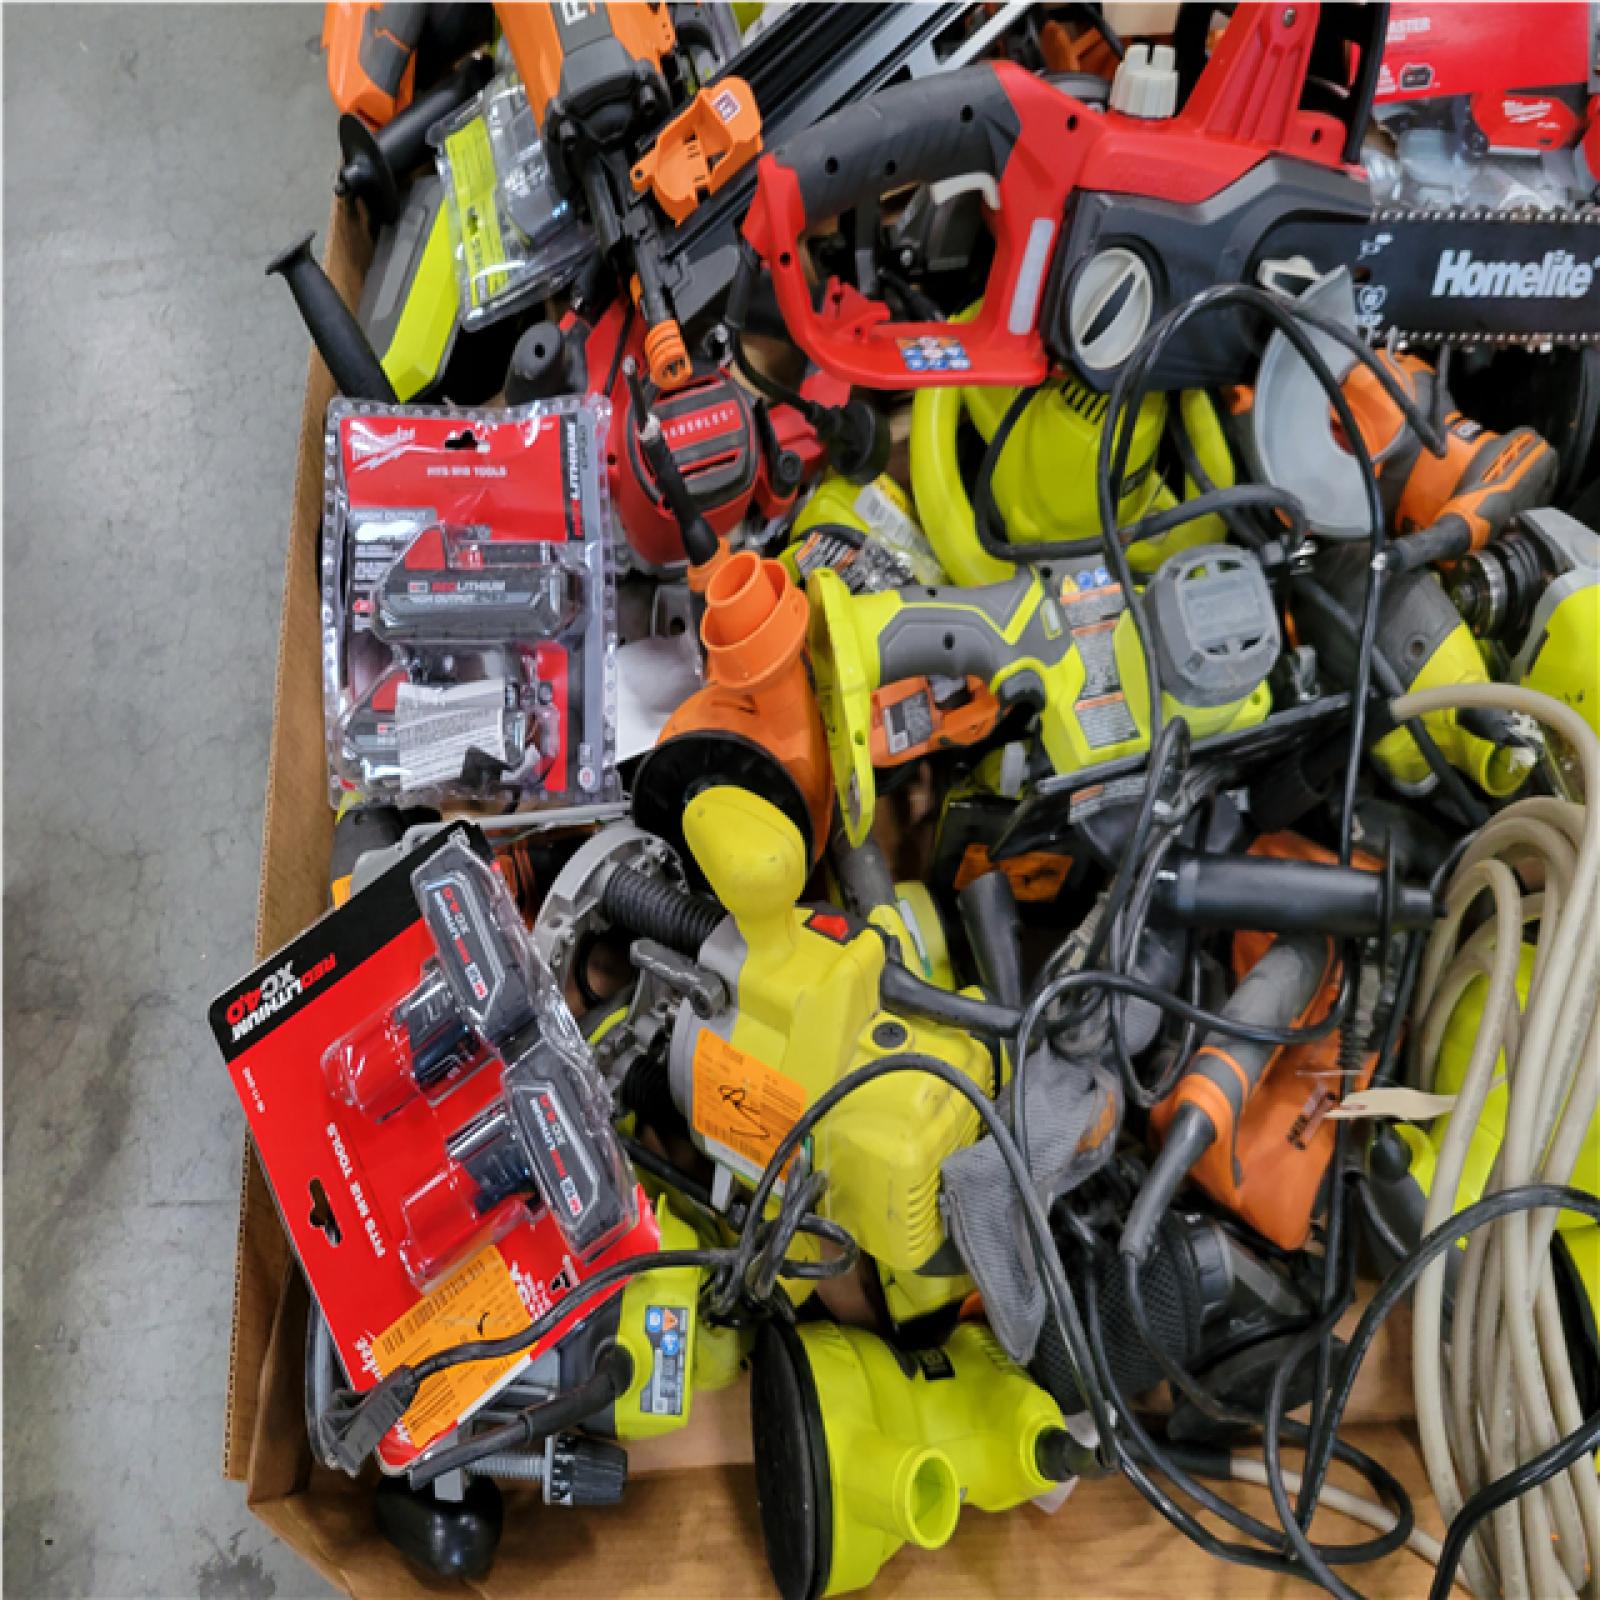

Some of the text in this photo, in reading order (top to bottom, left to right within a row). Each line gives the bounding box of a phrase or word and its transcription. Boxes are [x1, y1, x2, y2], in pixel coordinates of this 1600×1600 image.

[1431, 249, 1593, 298] Homelite
[226, 959, 295, 1026] XC4.0
[231, 951, 337, 1043] REDLITHIUM
[326, 1122, 353, 1180] TOOLS
